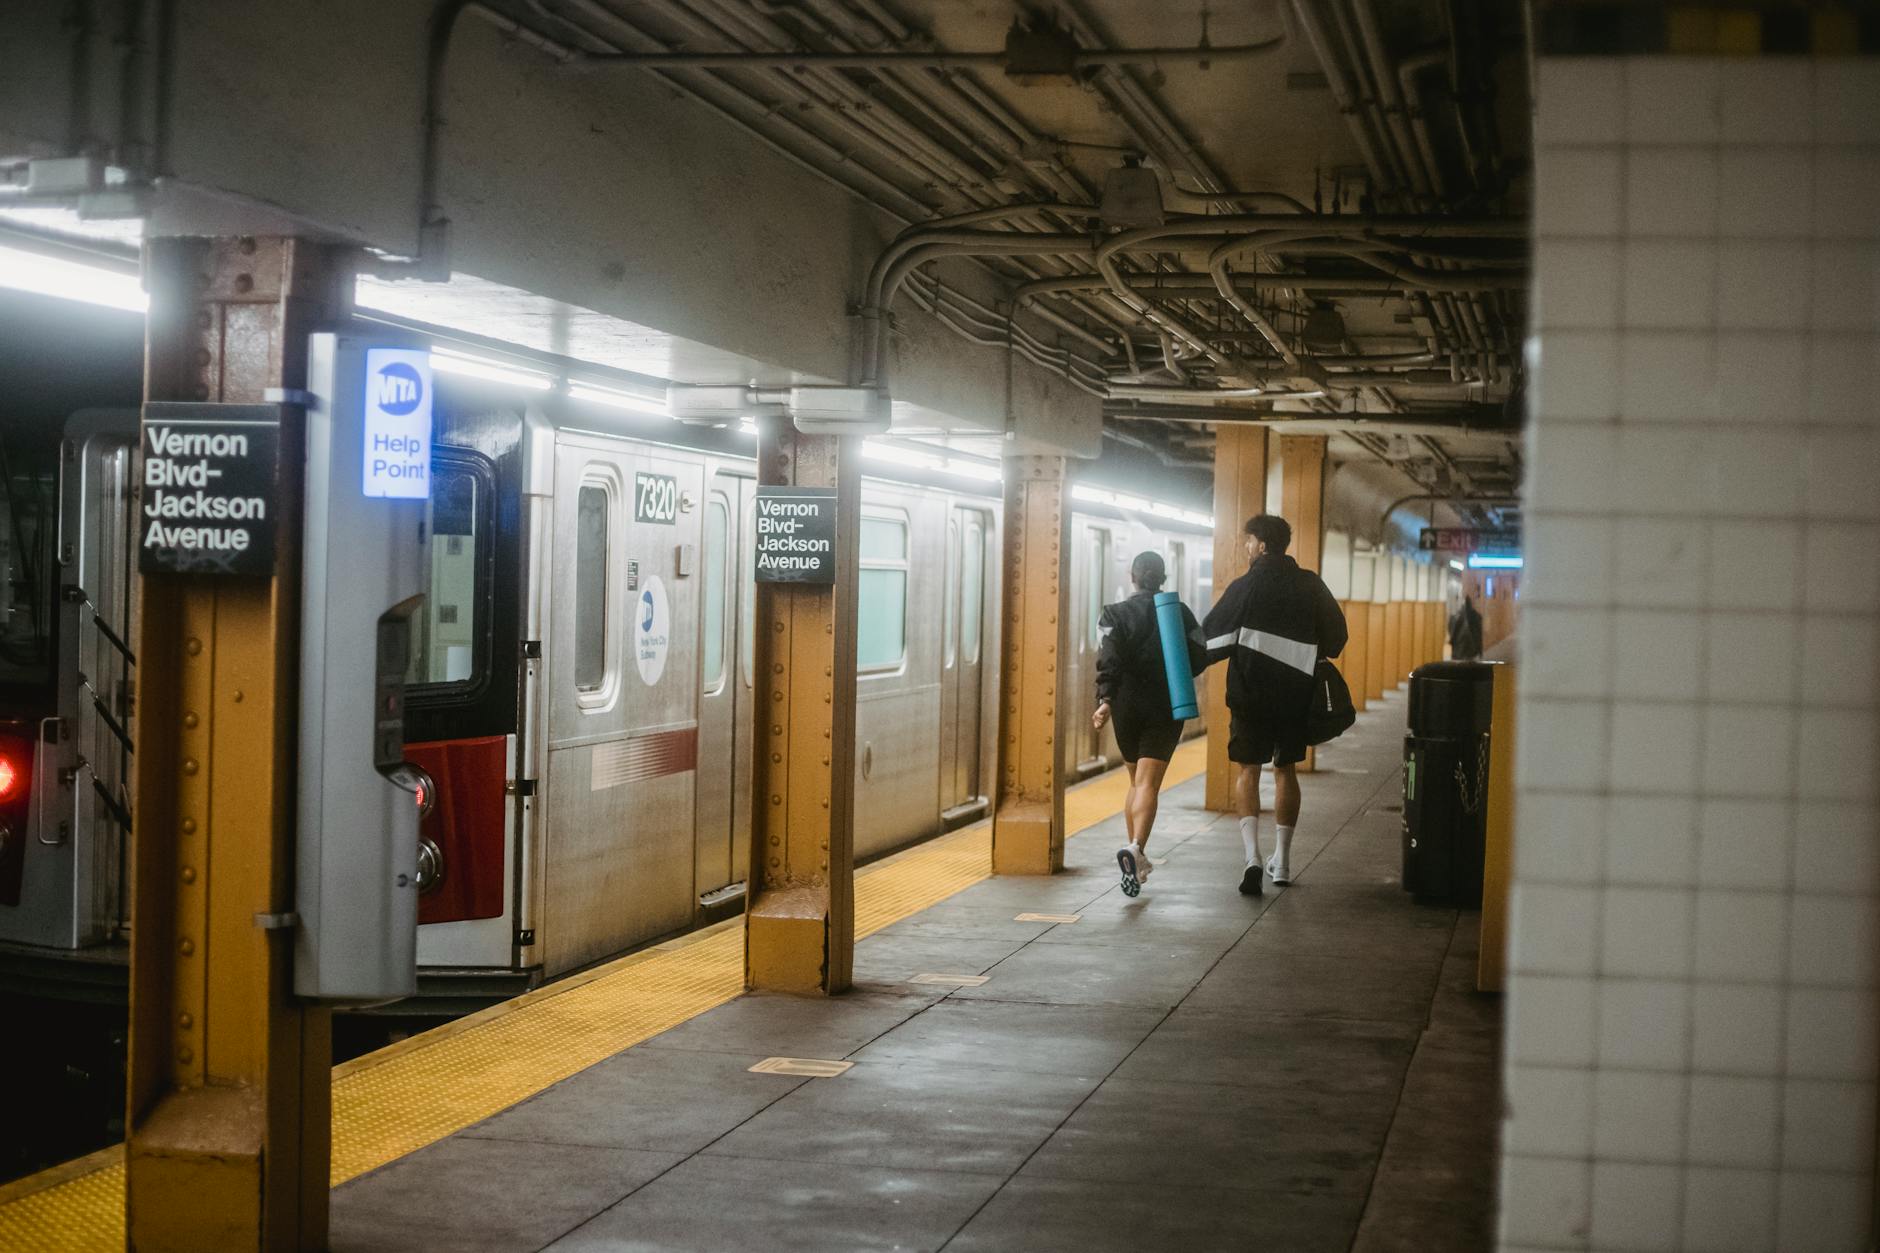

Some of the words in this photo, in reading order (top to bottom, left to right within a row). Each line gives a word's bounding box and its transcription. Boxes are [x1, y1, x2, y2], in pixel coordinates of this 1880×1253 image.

[379, 374, 417, 405] MTA
[147, 427, 248, 456] Vernon
[374, 433, 421, 458] Help
[145, 458, 222, 487] Blvd-
[373, 459, 424, 479] Point
[144, 489, 265, 519] Jackson
[637, 476, 676, 521] 7320
[759, 499, 819, 517] Vernon
[144, 520, 250, 551] Avenue
[758, 517, 804, 534] Blvd-
[757, 535, 830, 552] Jackson
[757, 552, 821, 570] Avenue
